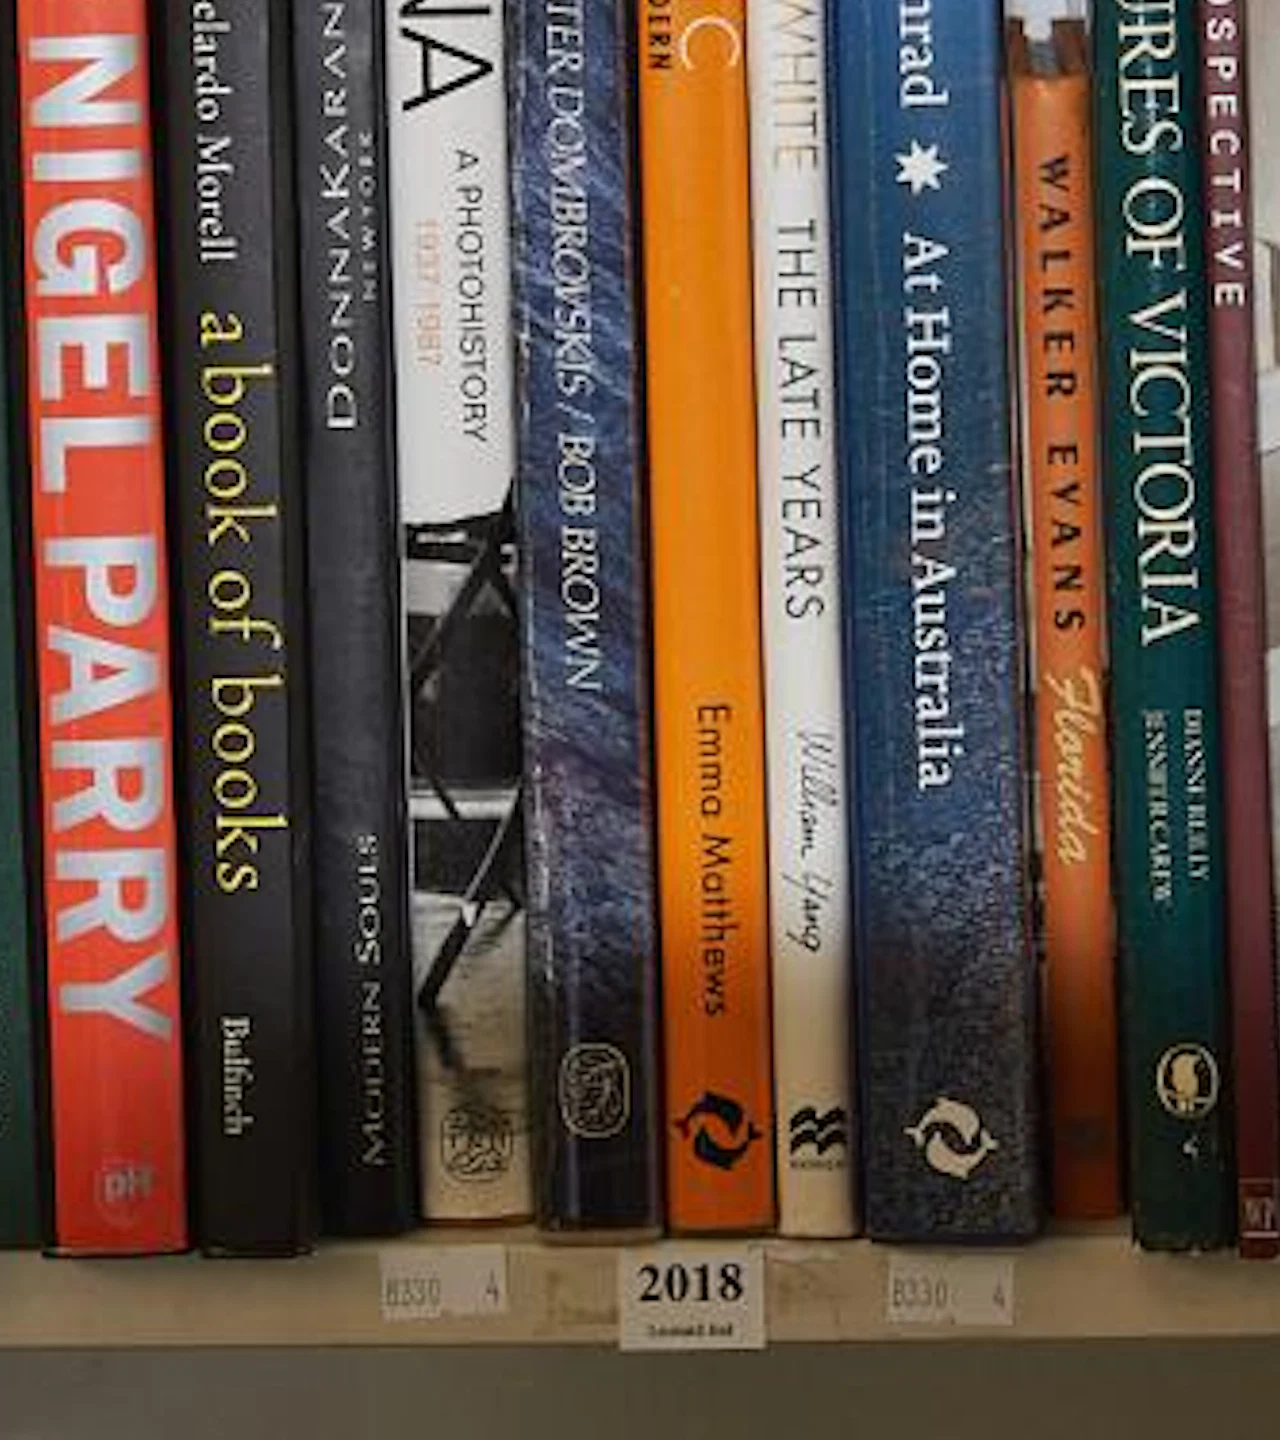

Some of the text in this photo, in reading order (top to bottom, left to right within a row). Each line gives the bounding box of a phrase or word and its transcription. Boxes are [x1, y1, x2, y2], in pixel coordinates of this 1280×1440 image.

[28, 33, 156, 493] NIGEL
[195, 133, 241, 262] Morell
[455, 149, 489, 445] A PHOTOHISTORY
[546, 83, 598, 397] DOMBROVSKIS
[778, 219, 818, 309] THE
[1122, 175, 1186, 273] OF
[557, 432, 597, 516] BOB
[778, 335, 821, 440] LATE
[1038, 153, 1087, 633] WALKER EVANS
[1128, 288, 1202, 648] VICTORIA
[199, 311, 288, 895] a book of books
[561, 523, 603, 693] BROWN
[782, 464, 825, 620] YEARS
[903, 231, 965, 792] At Home in Australia
[42, 534, 176, 1042] PARRY
[697, 704, 738, 1018] Emma Matthews
[782, 730, 838, 954] William Yang
[1042, 666, 1101, 866] Florida
[353, 833, 384, 965] SOULS
[221, 1015, 256, 1137] Bulfinch
[637, 1262, 743, 1302] 2018
